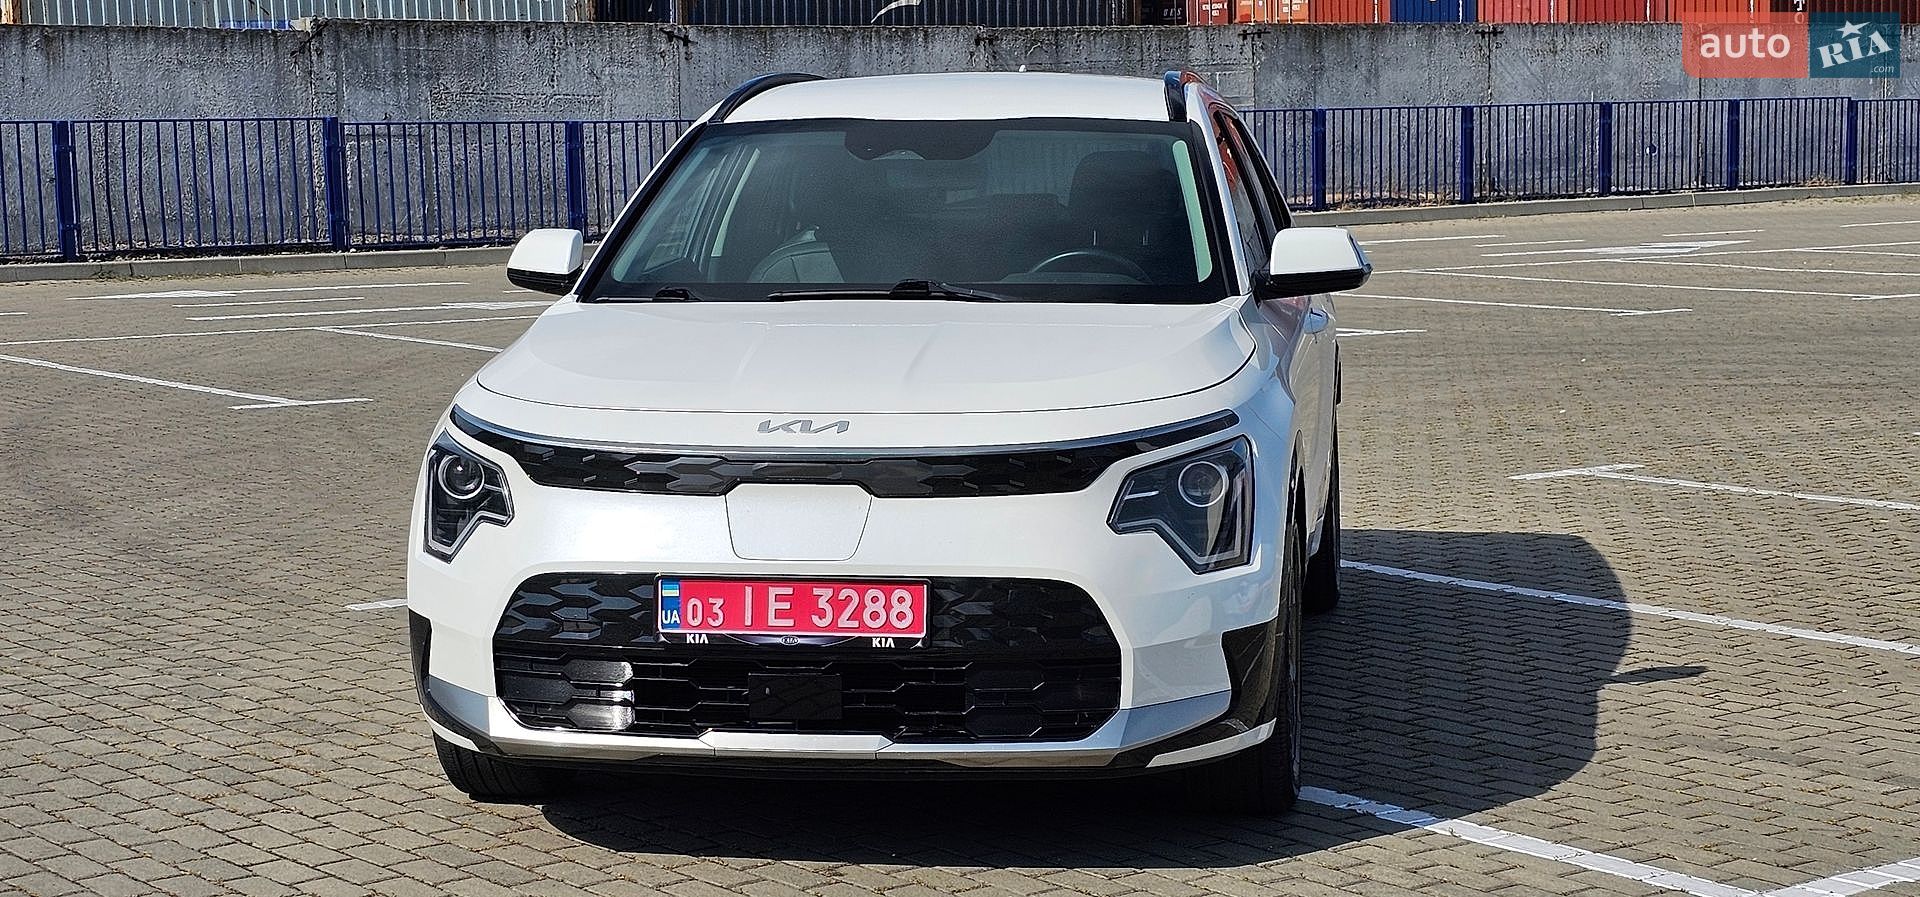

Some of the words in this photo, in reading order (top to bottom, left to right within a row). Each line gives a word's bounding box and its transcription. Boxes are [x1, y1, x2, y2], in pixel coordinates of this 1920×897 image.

[662, 609, 681, 625] UA
[686, 597, 724, 627] 03
[744, 585, 795, 627] IE
[811, 587, 914, 629] 3288
[686, 633, 709, 644] KIA
[872, 637, 895, 648] KIA
